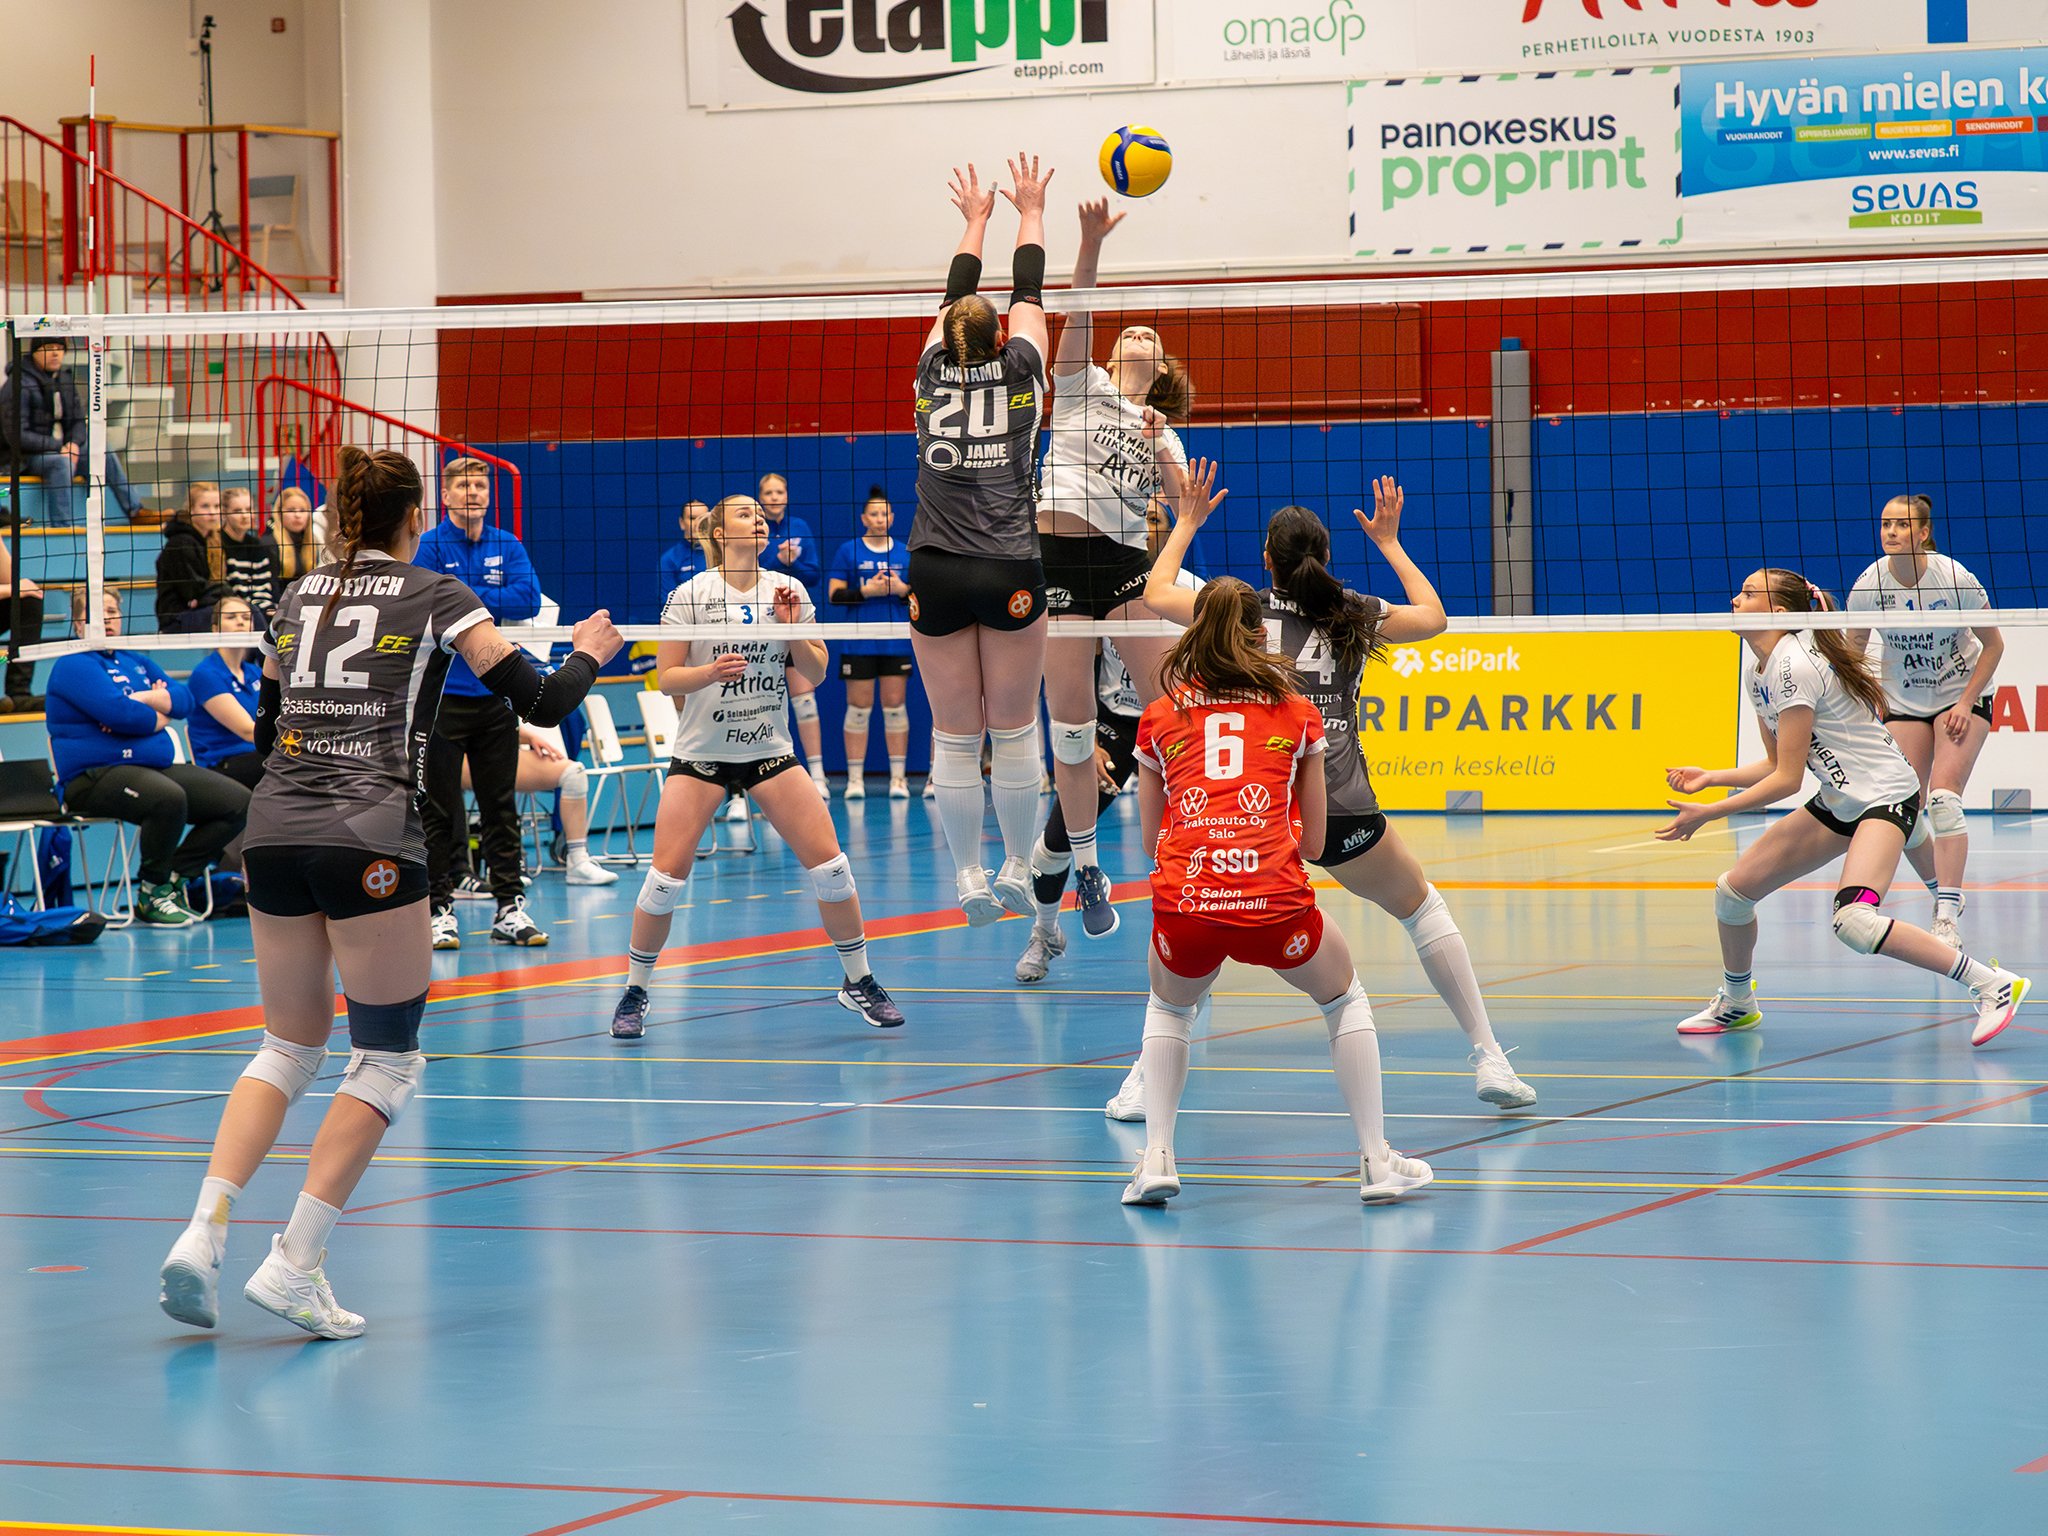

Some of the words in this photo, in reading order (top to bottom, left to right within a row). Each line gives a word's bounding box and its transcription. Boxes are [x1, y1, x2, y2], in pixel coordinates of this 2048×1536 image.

[1522, 32, 1658, 58] PERHETILOILTA
[1668, 29, 1765, 43] VUODESTA
[1776, 30, 1815, 44] 1903
[1224, 49, 1266, 62] Lähellä
[1268, 49, 1278, 61] ja
[1281, 47, 1311, 59] läsnä
[1014, 61, 1104, 79] etappi.com
[1715, 78, 1848, 126] Hyvän
[1863, 70, 2004, 113] mielen
[2019, 67, 2048, 105] k
[1869, 145, 1960, 161] www.sevas.fi
[1381, 136, 1647, 212] proprint
[1891, 213, 1941, 226] KODIT
[93, 353, 102, 412] Universal
[928, 385, 1008, 438] 20
[966, 443, 1007, 460] JAME
[1099, 453, 1150, 492] Atria
[741, 605, 753, 624] 3
[290, 605, 379, 689] 12
[377, 635, 413, 649] FF
[713, 641, 769, 654] HÄRMÄN
[1429, 646, 1521, 673] SeiPark
[1904, 653, 1944, 671] Atria
[720, 671, 776, 698] Atria
[289, 699, 386, 717] Säästöpankki
[307, 739, 372, 757] VOLUM
[1204, 712, 1245, 780] 6
[1454, 754, 1556, 776] keskellä
[1183, 816, 1246, 830] Traktoauto
[1250, 815, 1267, 829] Oy
[1209, 829, 1236, 838] Salo
[1212, 848, 1259, 873] SSO
[1200, 888, 1242, 898] Salon
[1198, 898, 1267, 912] Keilahalli
